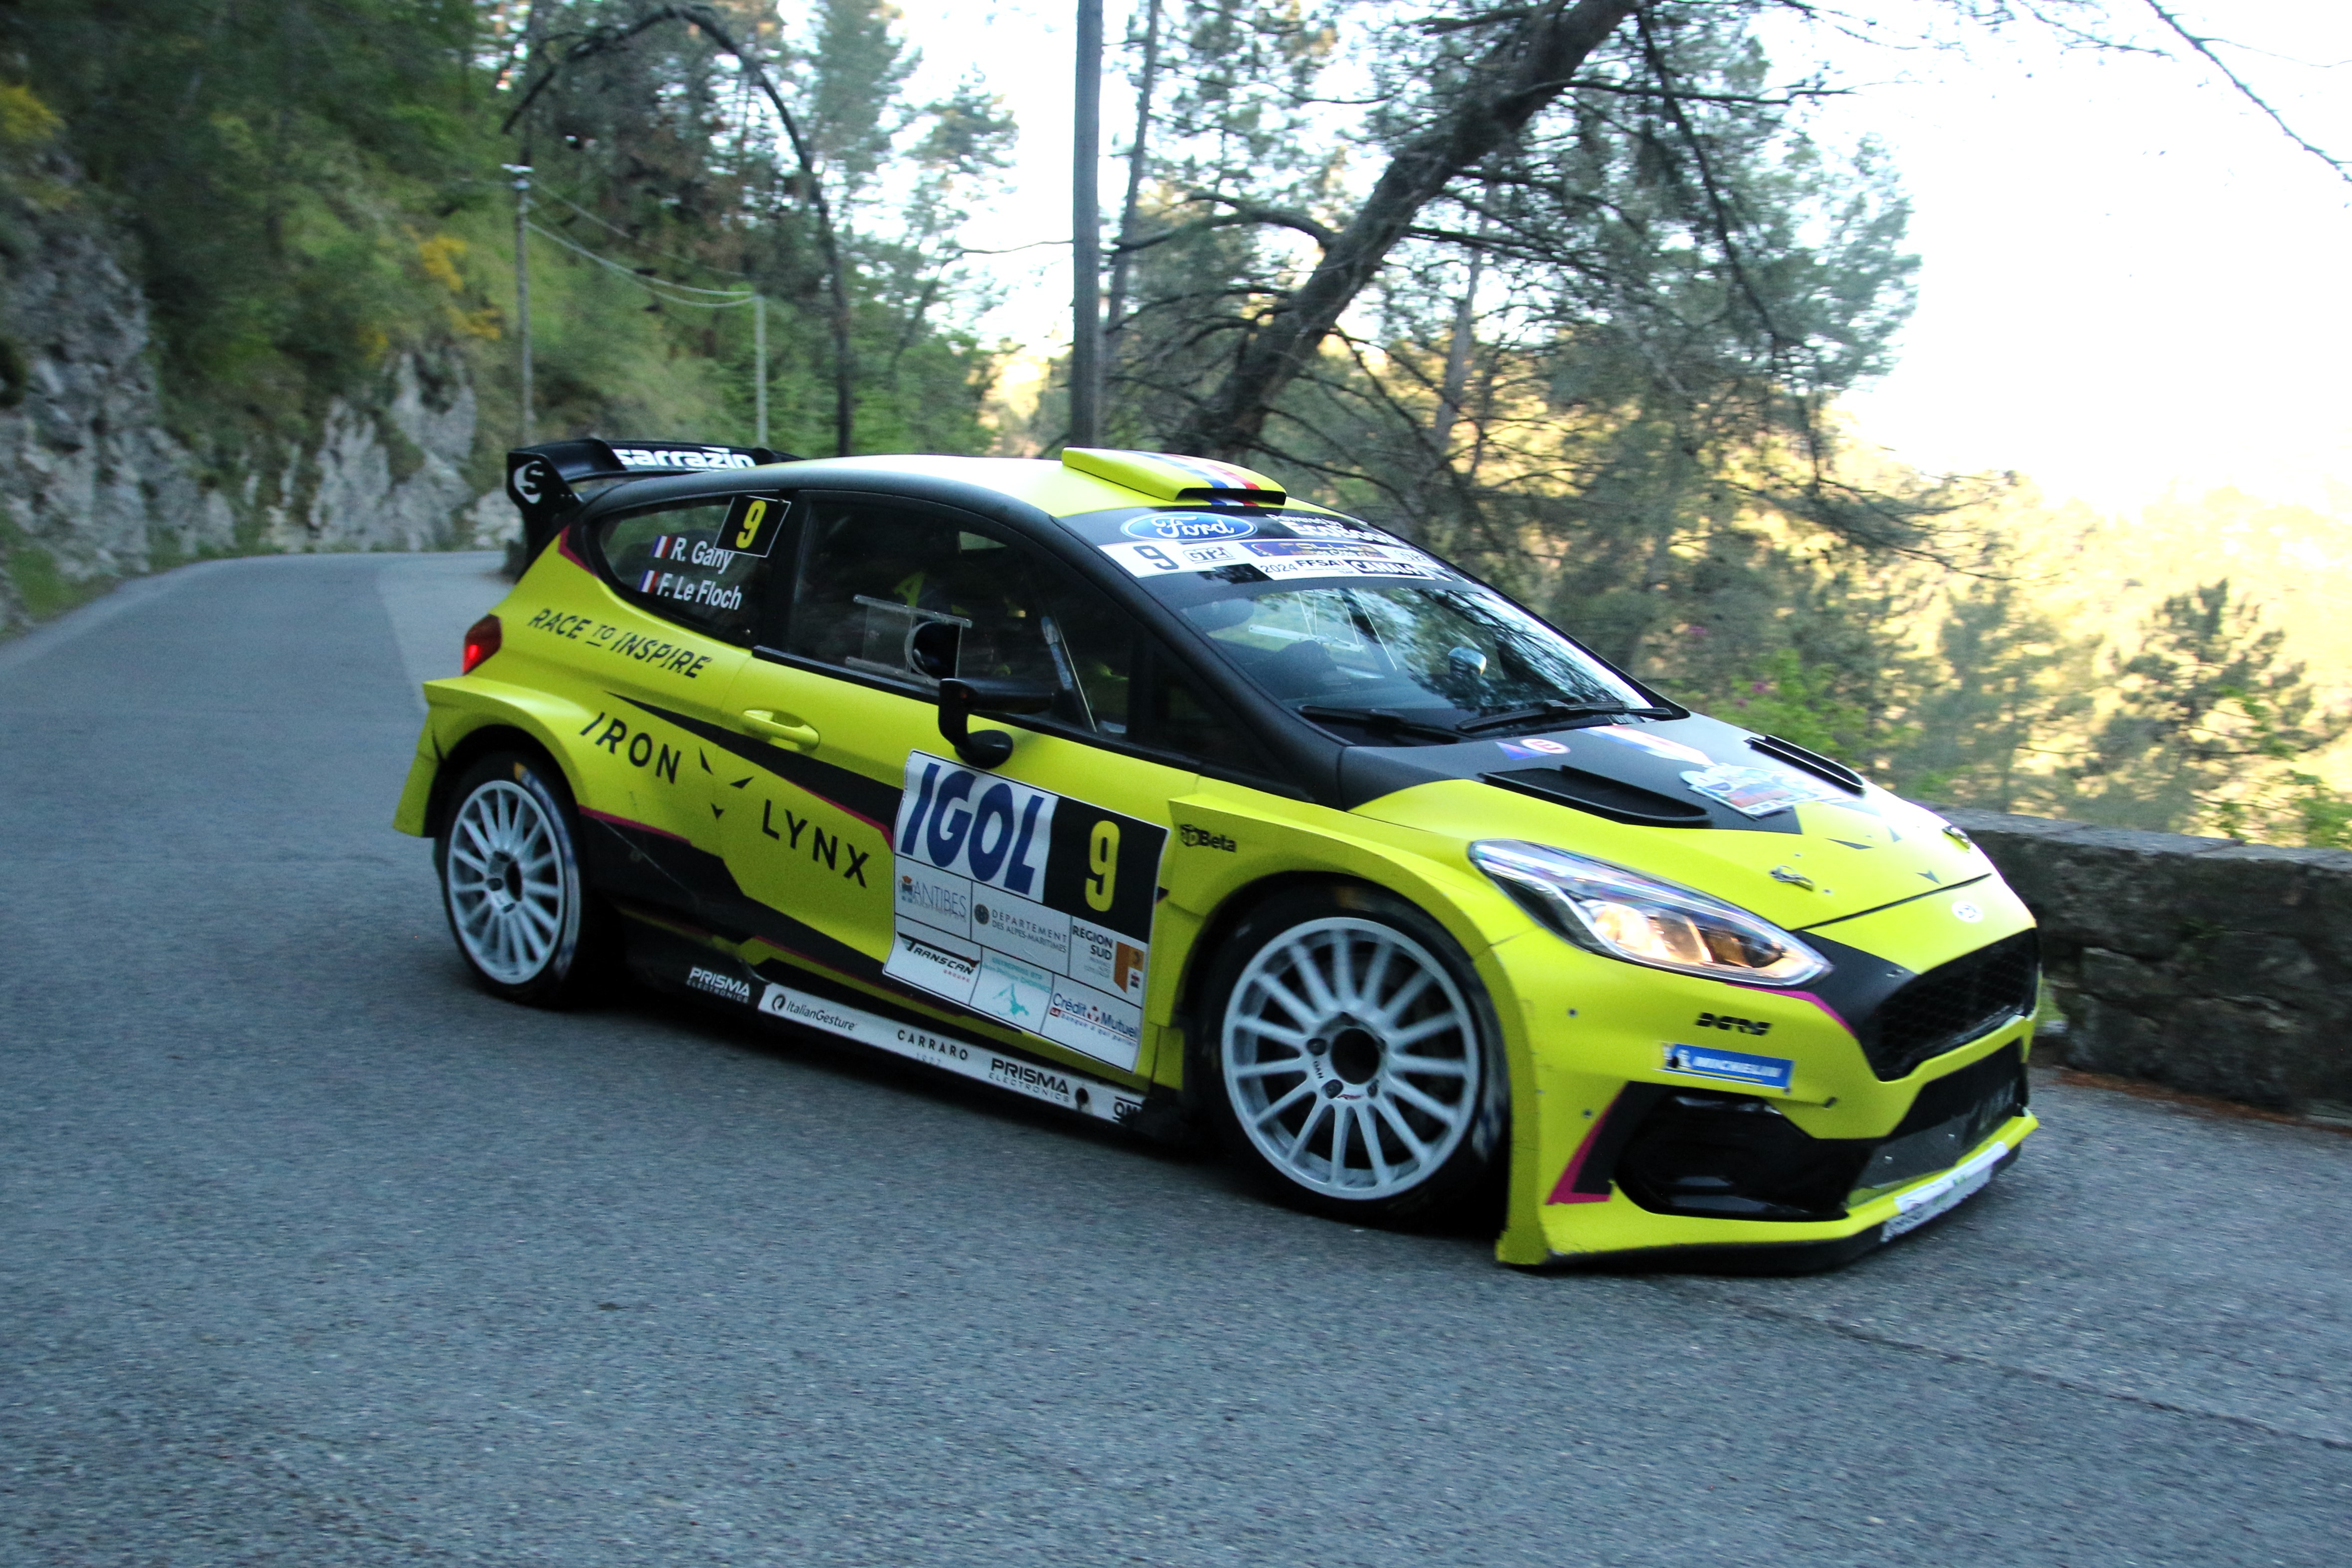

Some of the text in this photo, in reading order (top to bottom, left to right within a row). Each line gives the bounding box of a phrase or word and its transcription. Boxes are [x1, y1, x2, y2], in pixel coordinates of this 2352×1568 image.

[612, 447, 756, 469] sarrazin
[736, 500, 766, 549] 9
[1151, 516, 1235, 538] Ford
[670, 538, 734, 574] R. Gany
[1133, 545, 1179, 570] 9
[1260, 563, 1297, 573] 2024
[657, 573, 742, 610] F. Le Floch
[528, 608, 590, 640] RACE
[610, 632, 712, 678] INSPIRE
[580, 712, 681, 784] IRON
[762, 799, 871, 889] LYNX
[900, 763, 1044, 895] IGOL
[1199, 830, 1236, 853] Beta
[1085, 820, 1120, 912] 9
[914, 881, 967, 917] ANTIBES
[1072, 925, 1113, 949] RÉGION
[1090, 945, 1112, 961] SUD
[686, 979, 749, 1003] ELECTRONICS
[689, 967, 752, 998] PRISMA
[786, 1000, 854, 1031] ItalianGesture
[1053, 993, 1139, 1037] Crédit Mutuel
[898, 1029, 968, 1061] CARRARO
[990, 1056, 1069, 1095] PRISMA
[1693, 1056, 1783, 1078] MICHELIN
[988, 1072, 1070, 1104] ELECTRONICS
